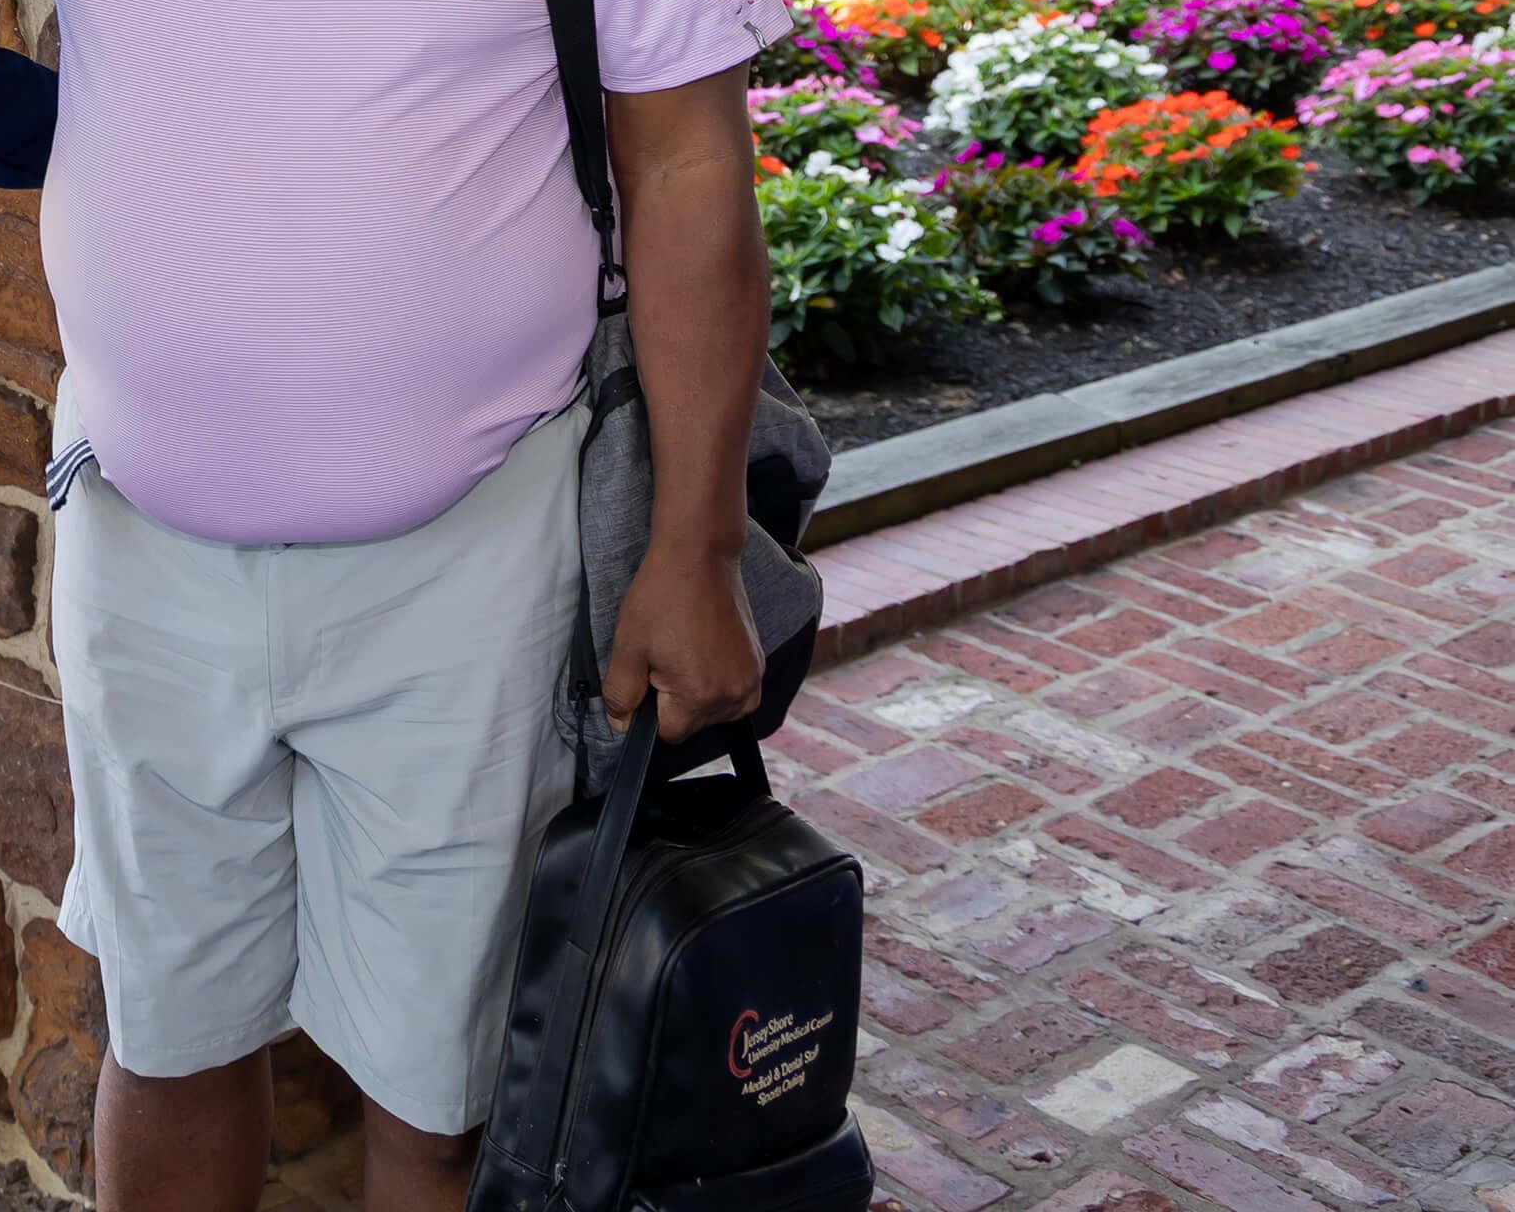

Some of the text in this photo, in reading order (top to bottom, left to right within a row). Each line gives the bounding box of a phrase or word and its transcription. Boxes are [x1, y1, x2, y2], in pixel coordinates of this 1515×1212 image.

[741, 1013, 794, 1059] Jersey Shore
[747, 1037, 781, 1065] University
[780, 1021, 810, 1046] Medical
[741, 1069, 773, 1095] Medical
[773, 1067, 781, 1081] &
